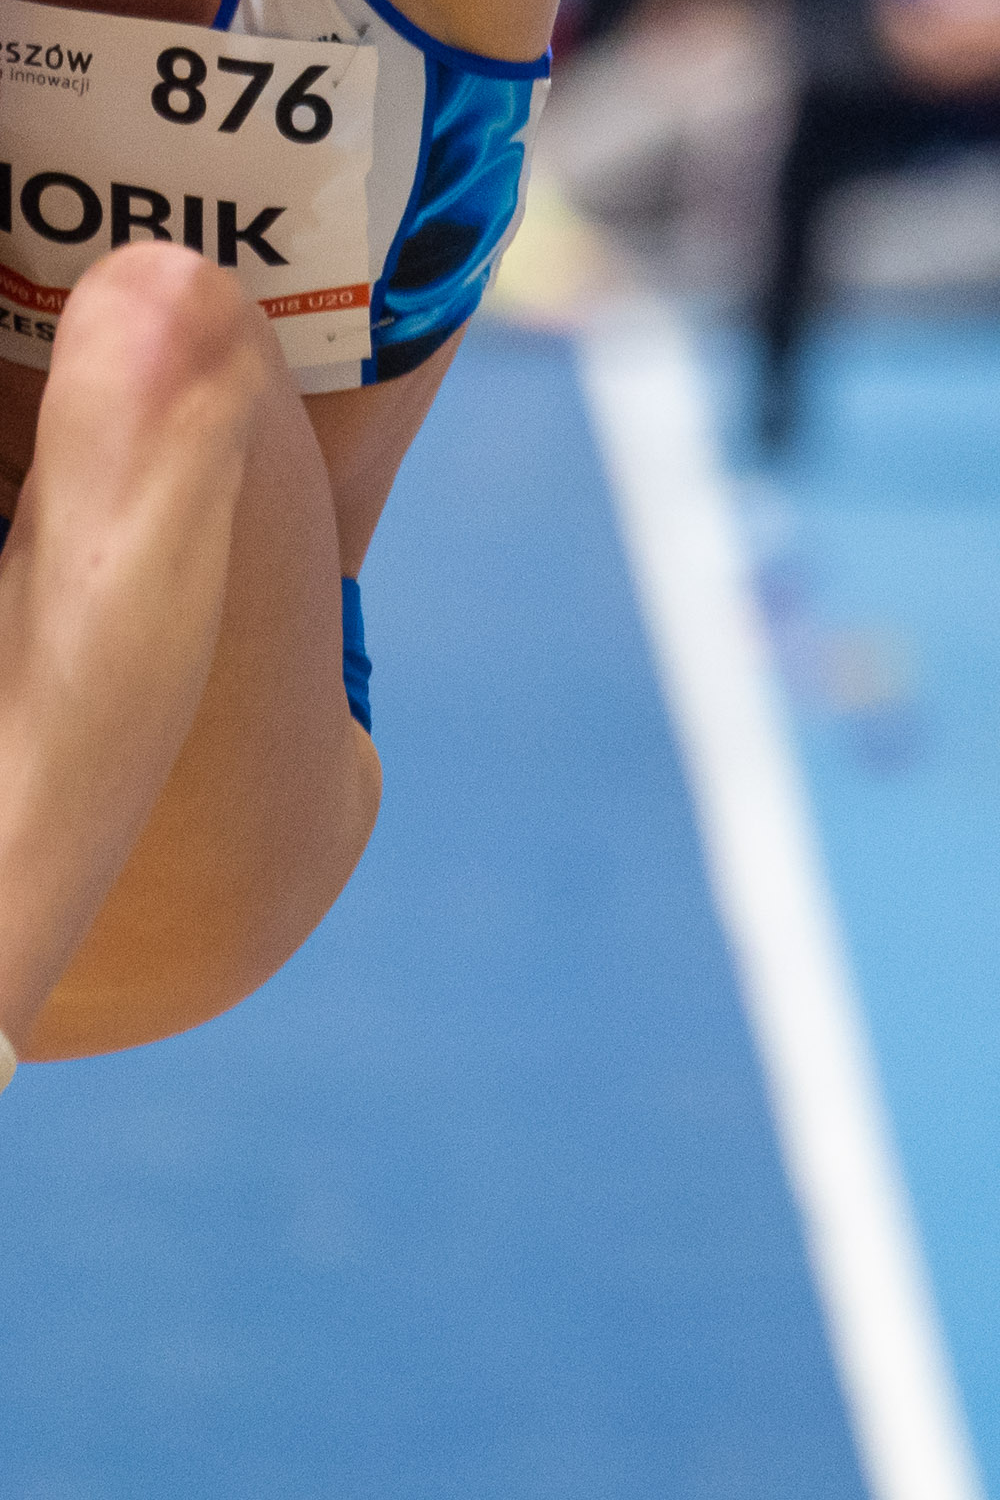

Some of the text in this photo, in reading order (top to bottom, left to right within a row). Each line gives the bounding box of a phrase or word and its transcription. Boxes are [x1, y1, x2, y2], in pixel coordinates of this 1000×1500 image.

[9, 67, 90, 97] innowacji
[150, 46, 334, 145] 876
[308, 291, 353, 309] U20
